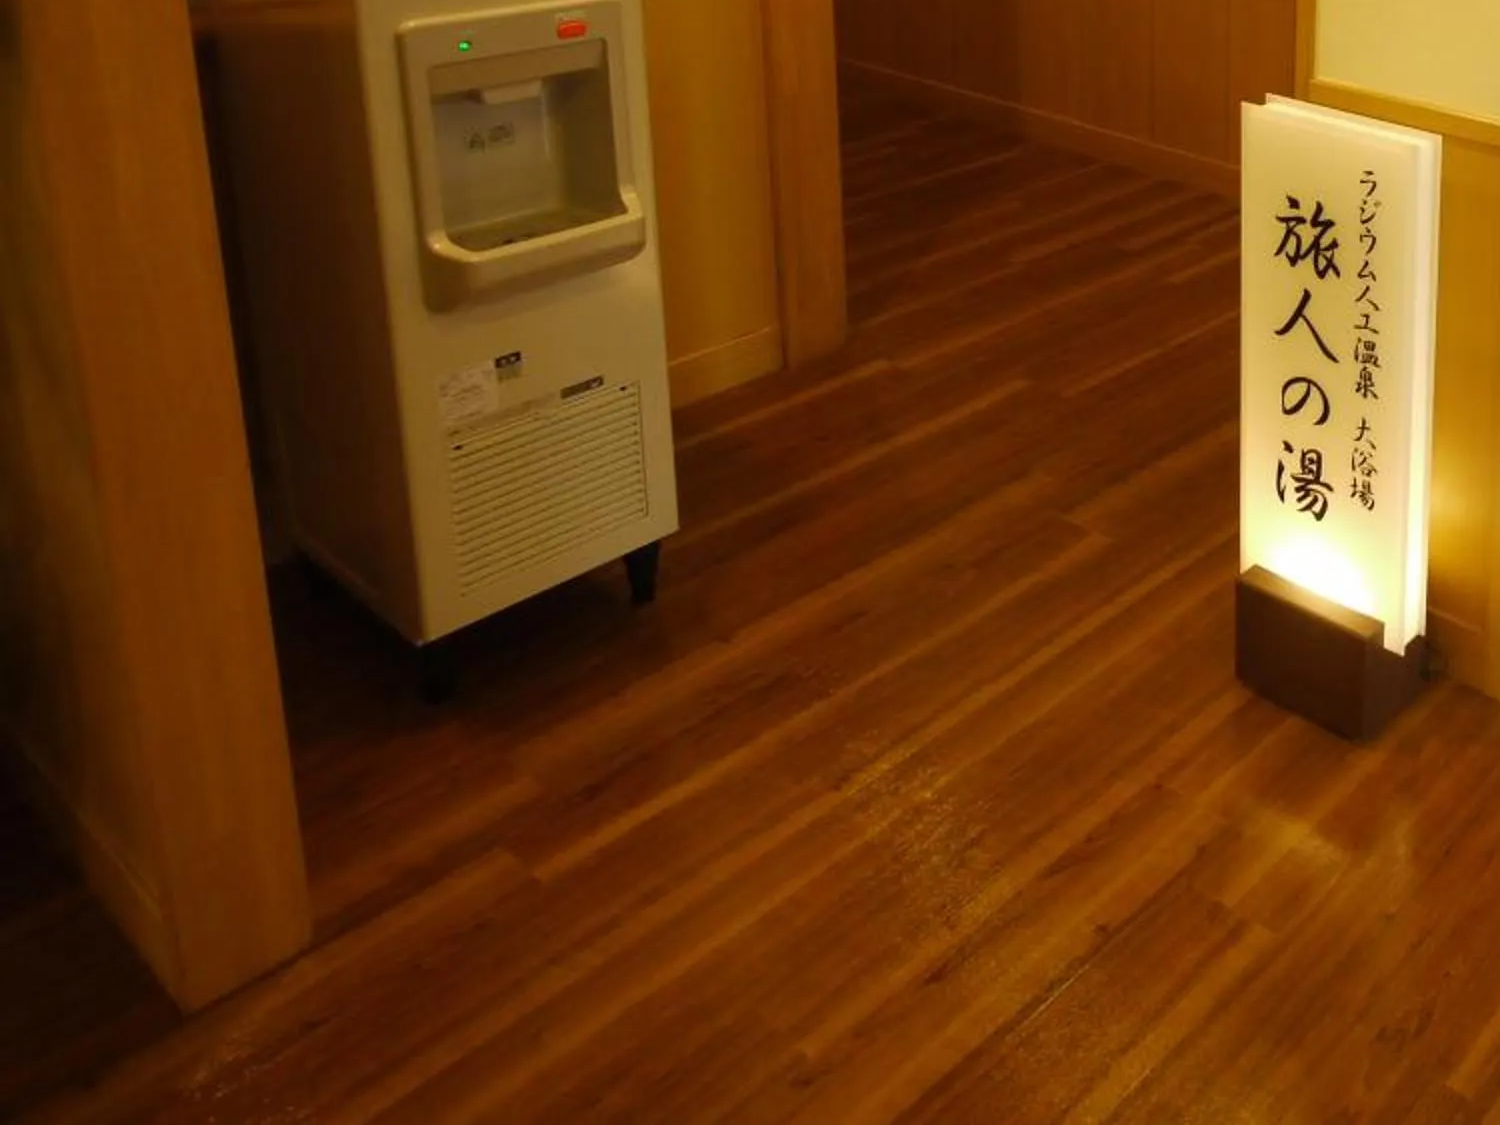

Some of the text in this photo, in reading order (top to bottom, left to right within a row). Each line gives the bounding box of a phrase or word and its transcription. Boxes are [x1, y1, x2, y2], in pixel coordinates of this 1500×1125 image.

[1274, 194, 1342, 523] 旅人の湯
[1350, 170, 1382, 512] ラジウム人工温泉 大浴場
